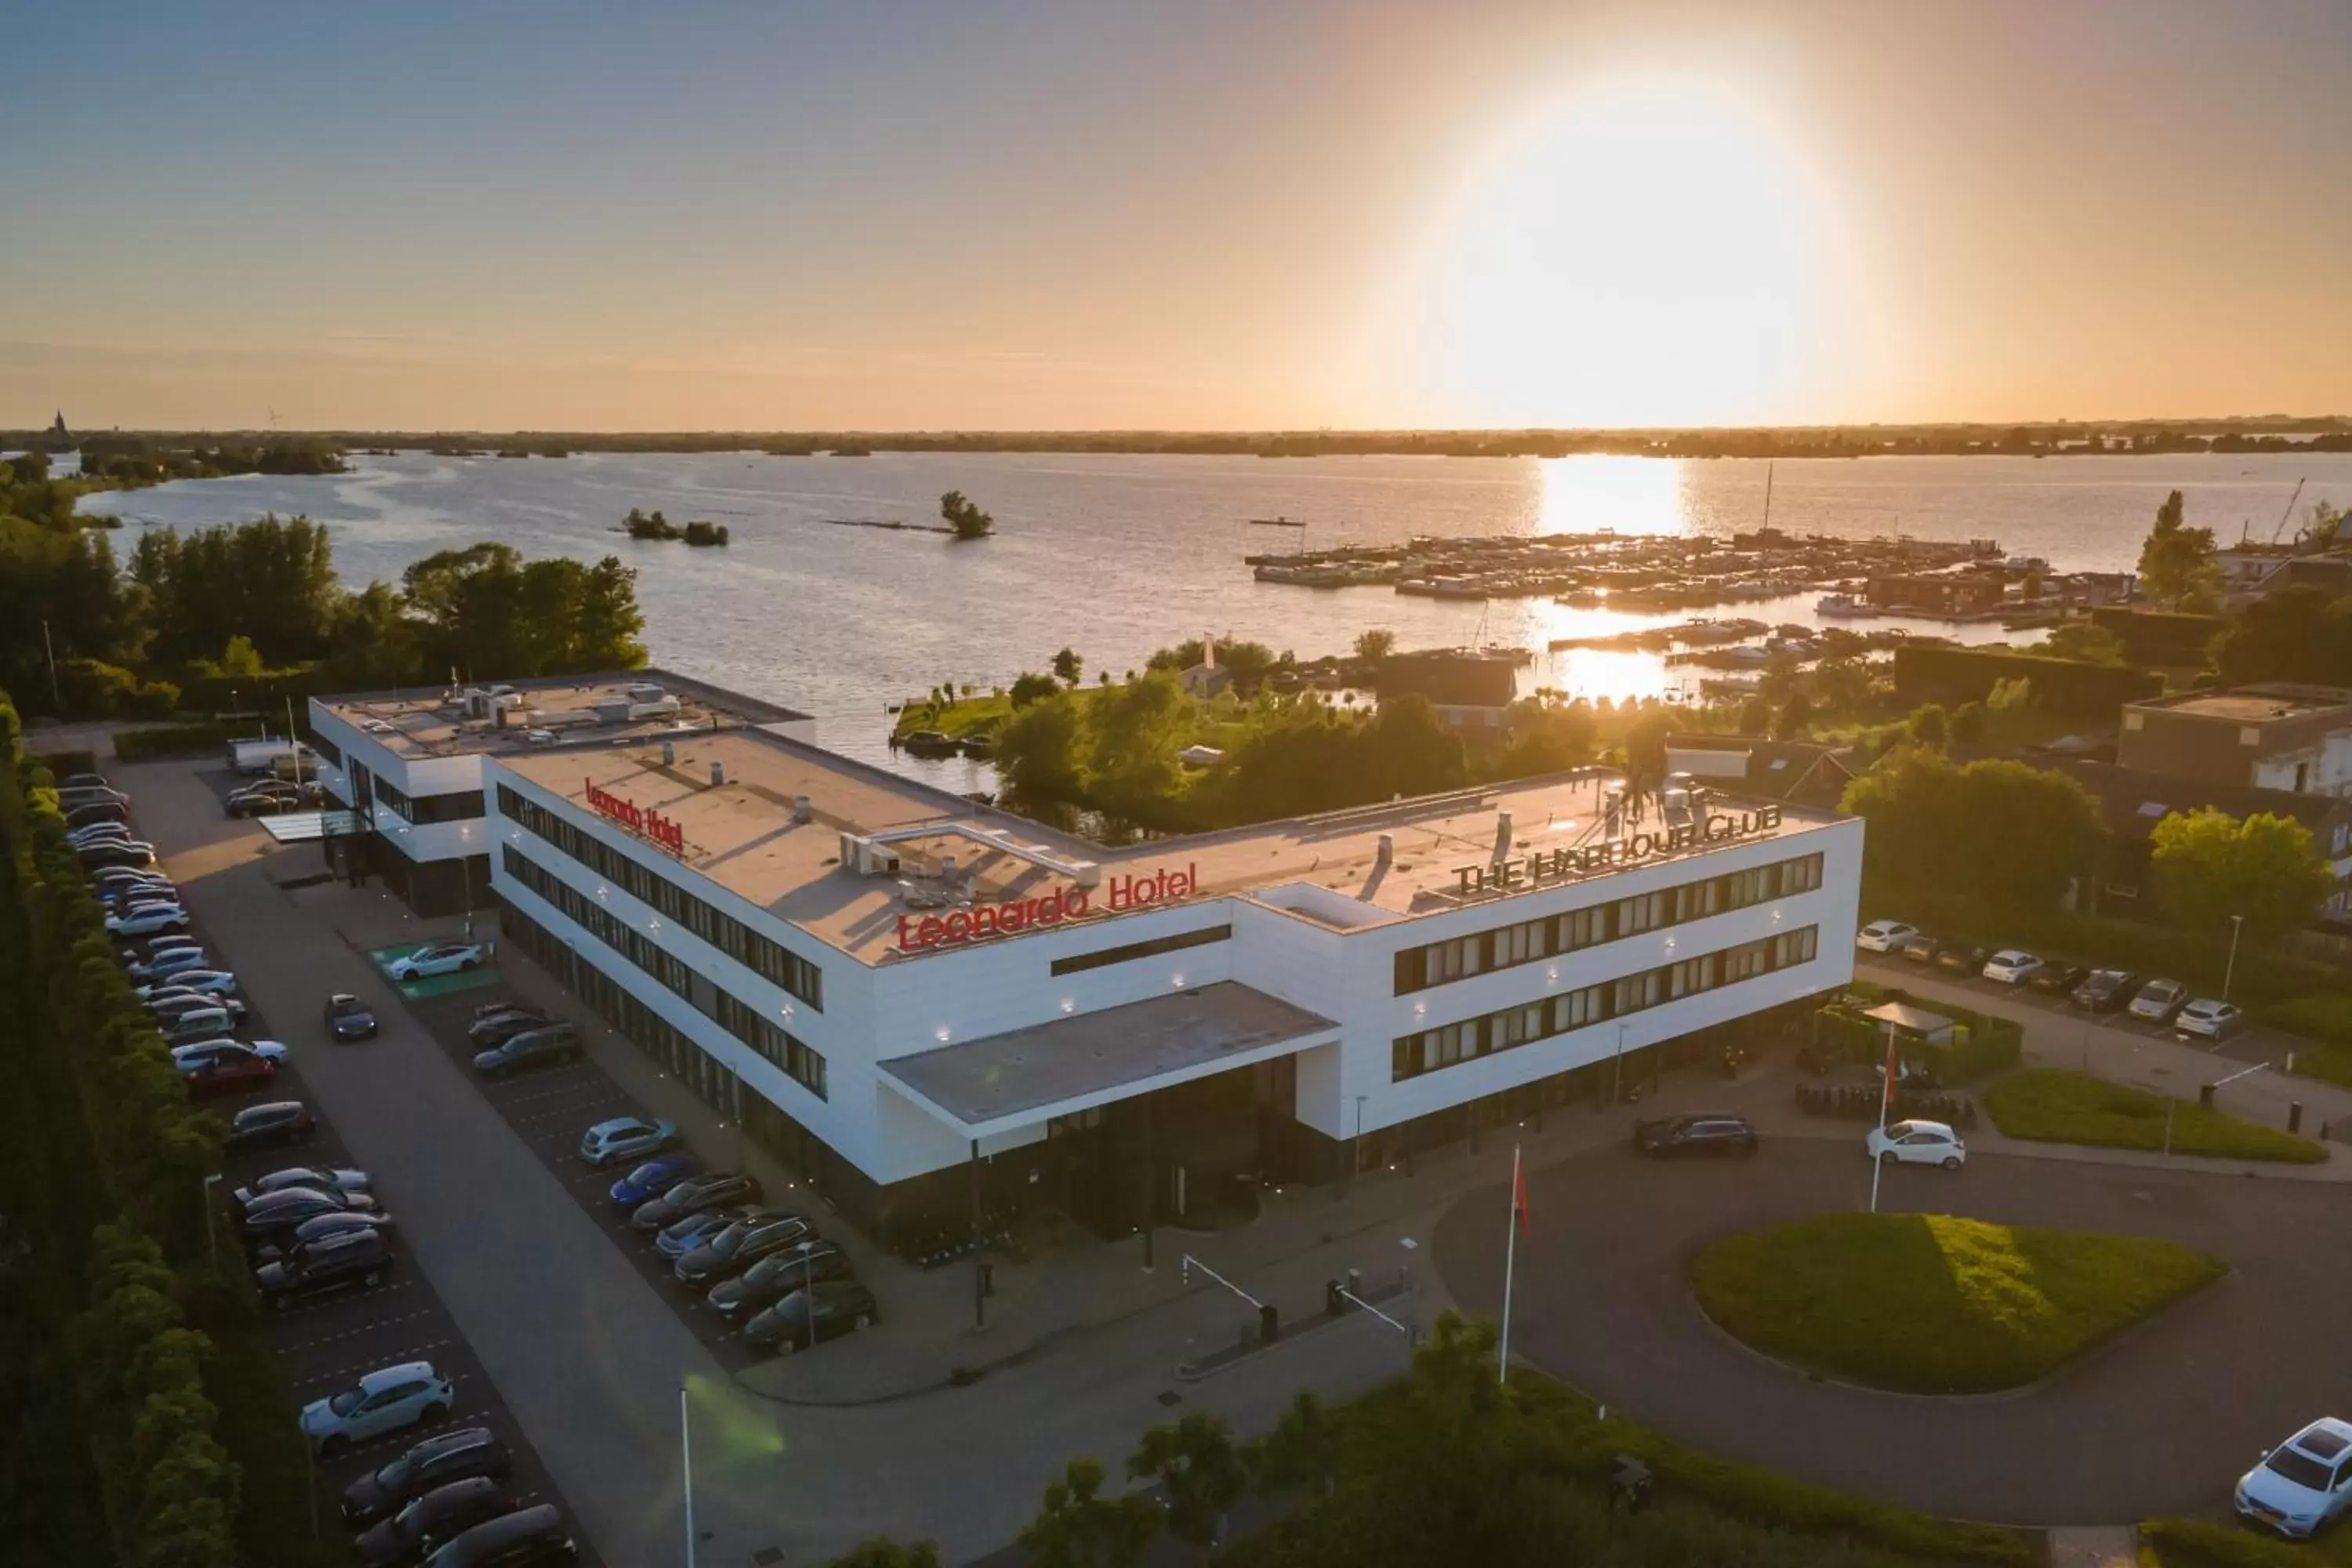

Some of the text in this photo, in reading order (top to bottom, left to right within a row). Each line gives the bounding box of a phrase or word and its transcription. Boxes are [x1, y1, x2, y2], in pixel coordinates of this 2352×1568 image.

[585, 777, 682, 851] Leonardo Hotel
[1451, 805, 1781, 895] THE HARBOUR CLUB
[896, 863, 1196, 950] Leonardo Hotel
